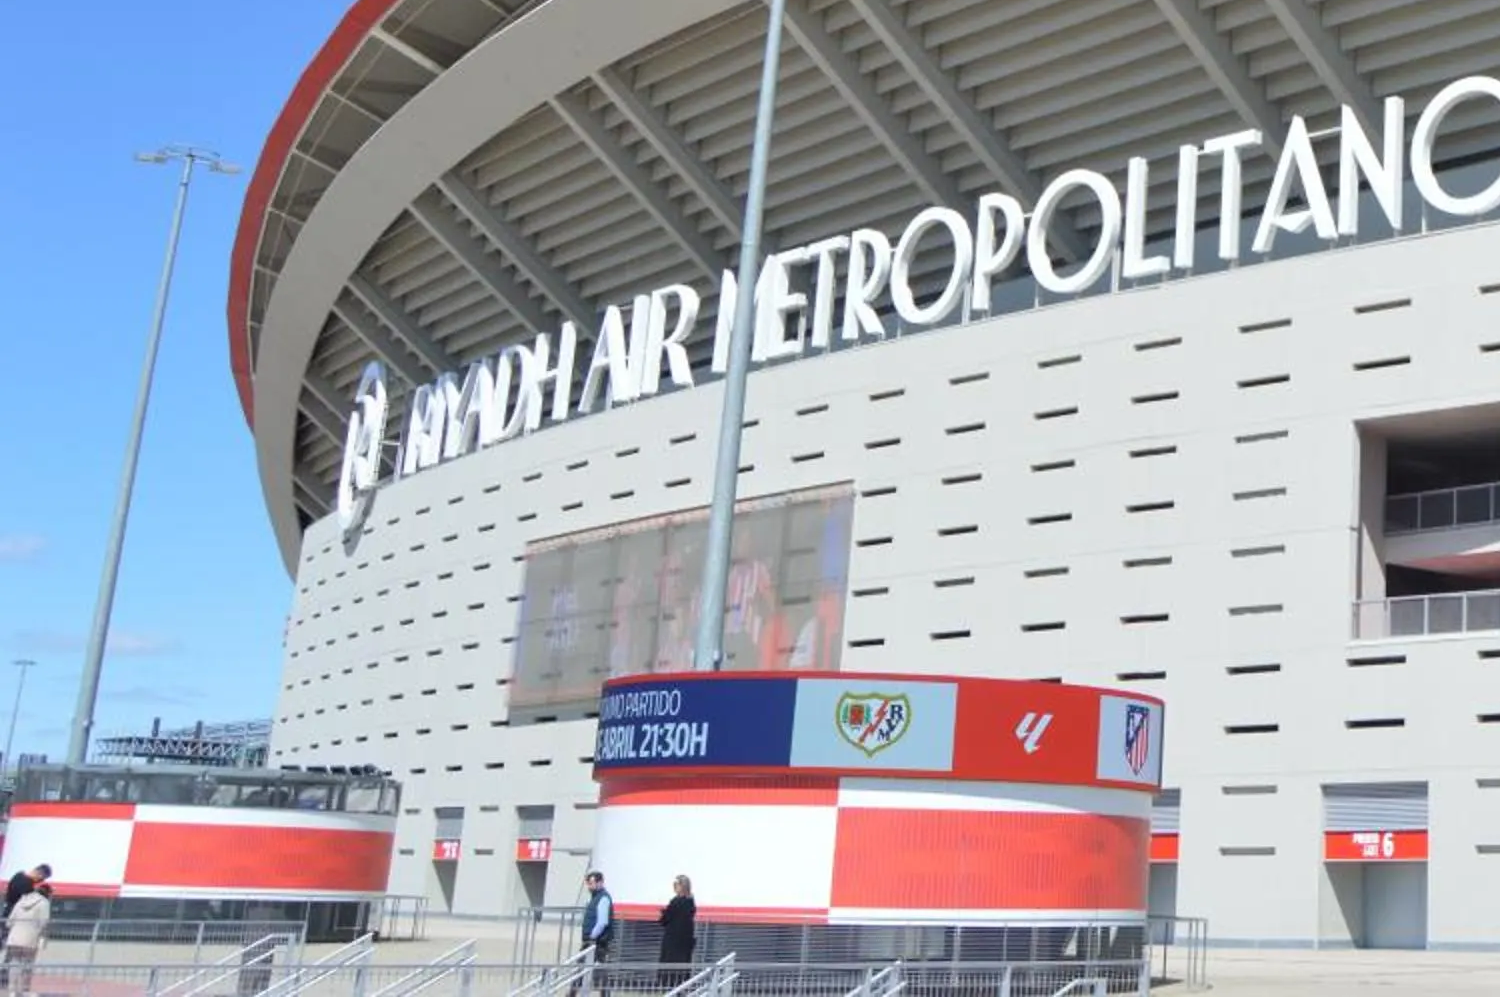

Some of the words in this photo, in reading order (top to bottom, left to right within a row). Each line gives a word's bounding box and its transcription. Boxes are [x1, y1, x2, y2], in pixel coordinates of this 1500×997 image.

[577, 284, 700, 415] AIR
[625, 688, 682, 717] PARTIDO
[639, 721, 709, 759] 21:30H
[1382, 831, 1394, 858] 6
